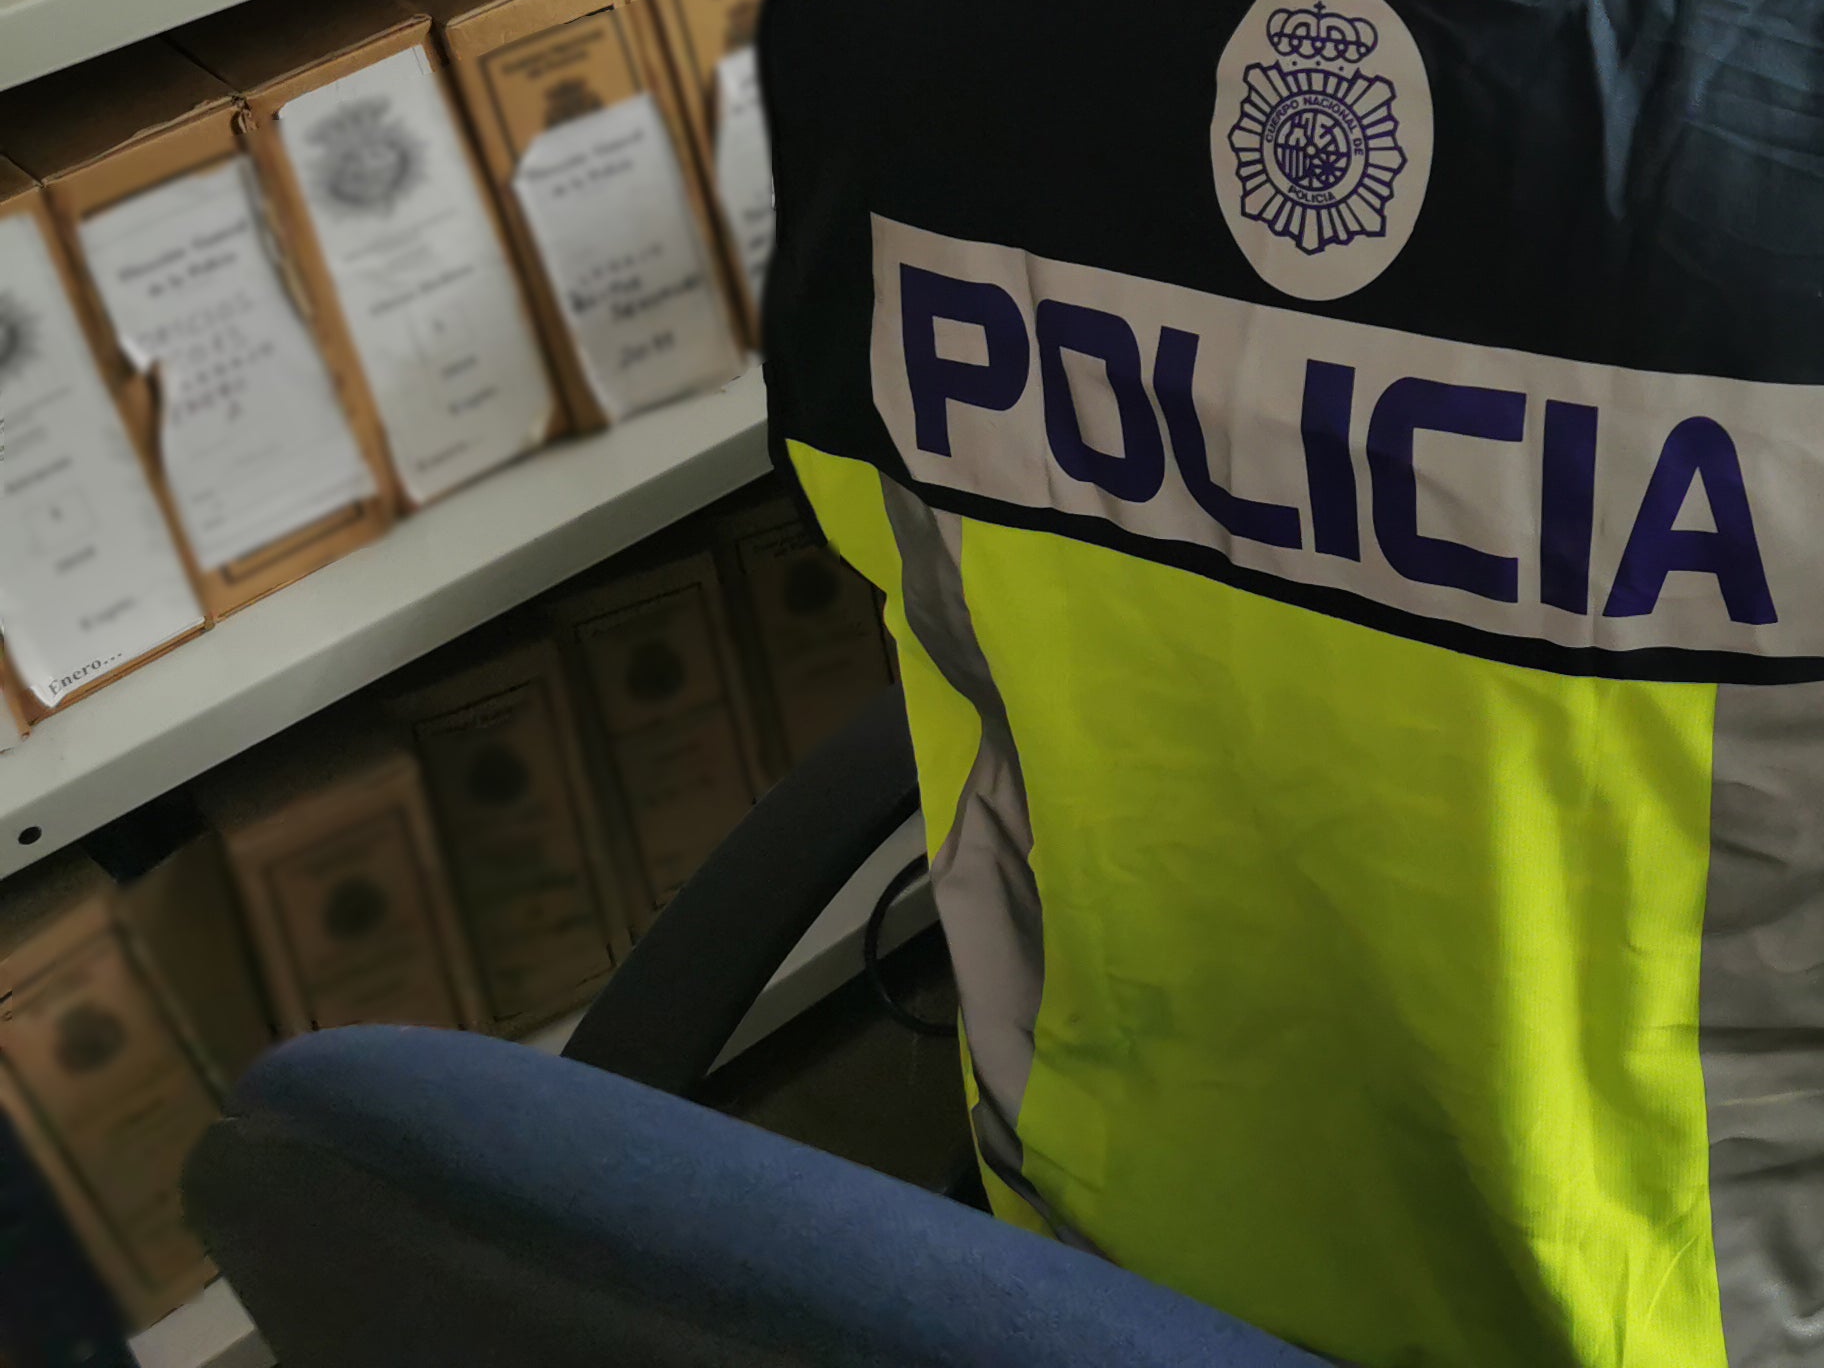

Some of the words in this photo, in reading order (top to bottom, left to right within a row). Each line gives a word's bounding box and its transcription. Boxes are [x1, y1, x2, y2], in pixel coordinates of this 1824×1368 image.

[1264, 100, 1300, 143] CUERPO
[1302, 95, 1359, 133] NACIONAL
[1352, 137, 1365, 157] DE
[1287, 185, 1337, 204] POLICIA
[898, 263, 1779, 626] POLICIA
